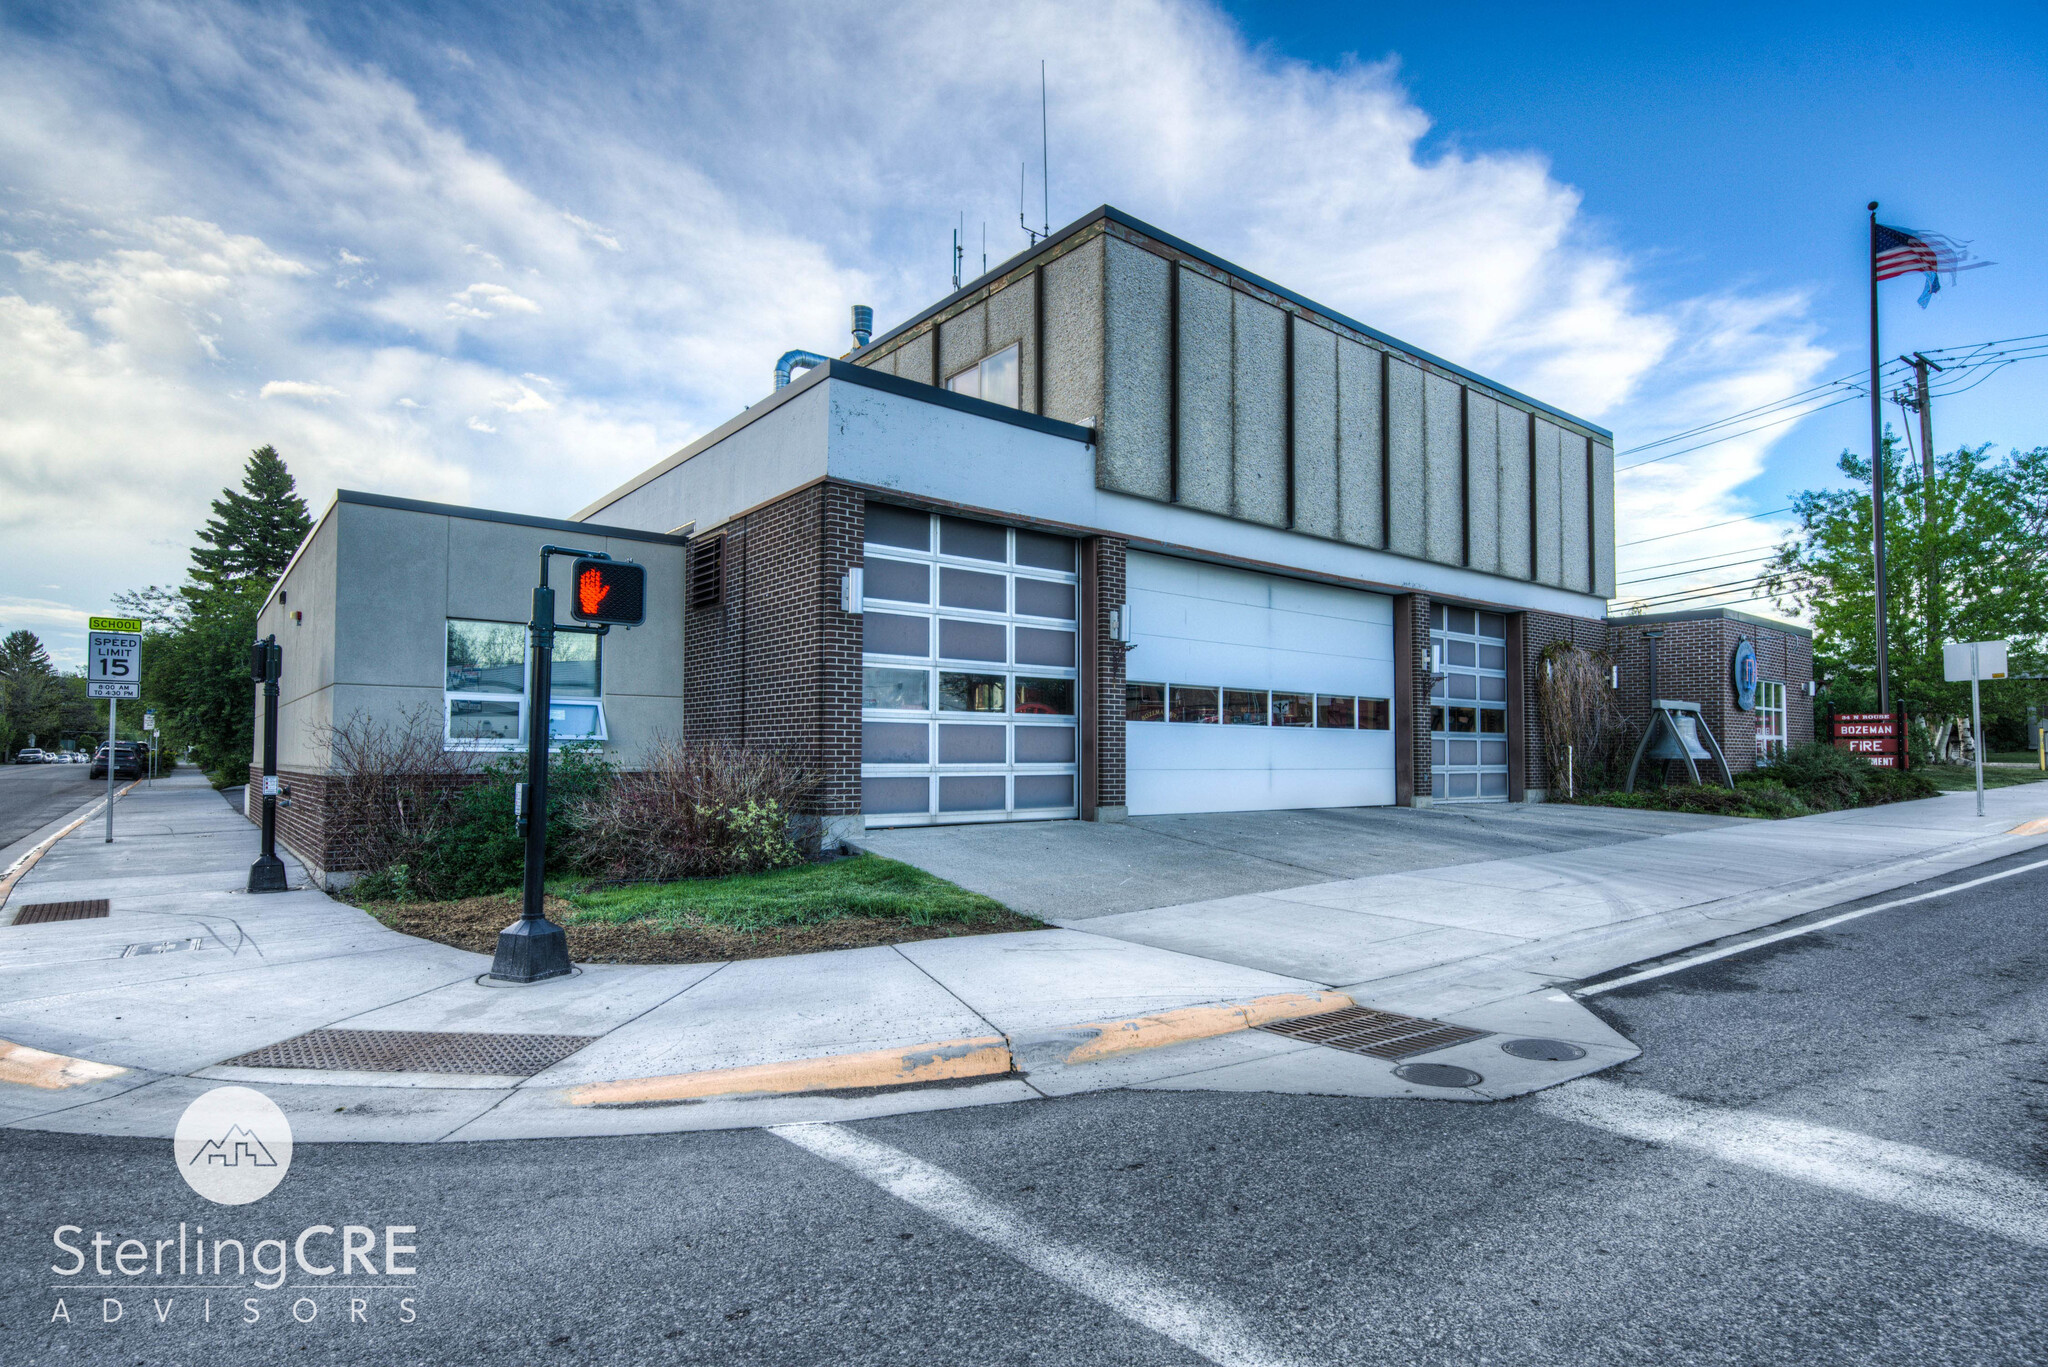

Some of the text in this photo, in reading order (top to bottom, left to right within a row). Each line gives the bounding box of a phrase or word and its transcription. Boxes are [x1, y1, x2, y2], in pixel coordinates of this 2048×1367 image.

[93, 620, 139, 629] SCHOOL
[94, 638, 137, 647] SPEED
[98, 648, 132, 656] LIMIT
[100, 658, 130, 676] 15
[1841, 726, 1892, 735] BOZEMAN
[1850, 741, 1883, 752] FIRE
[1867, 758, 1893, 766] MENT
